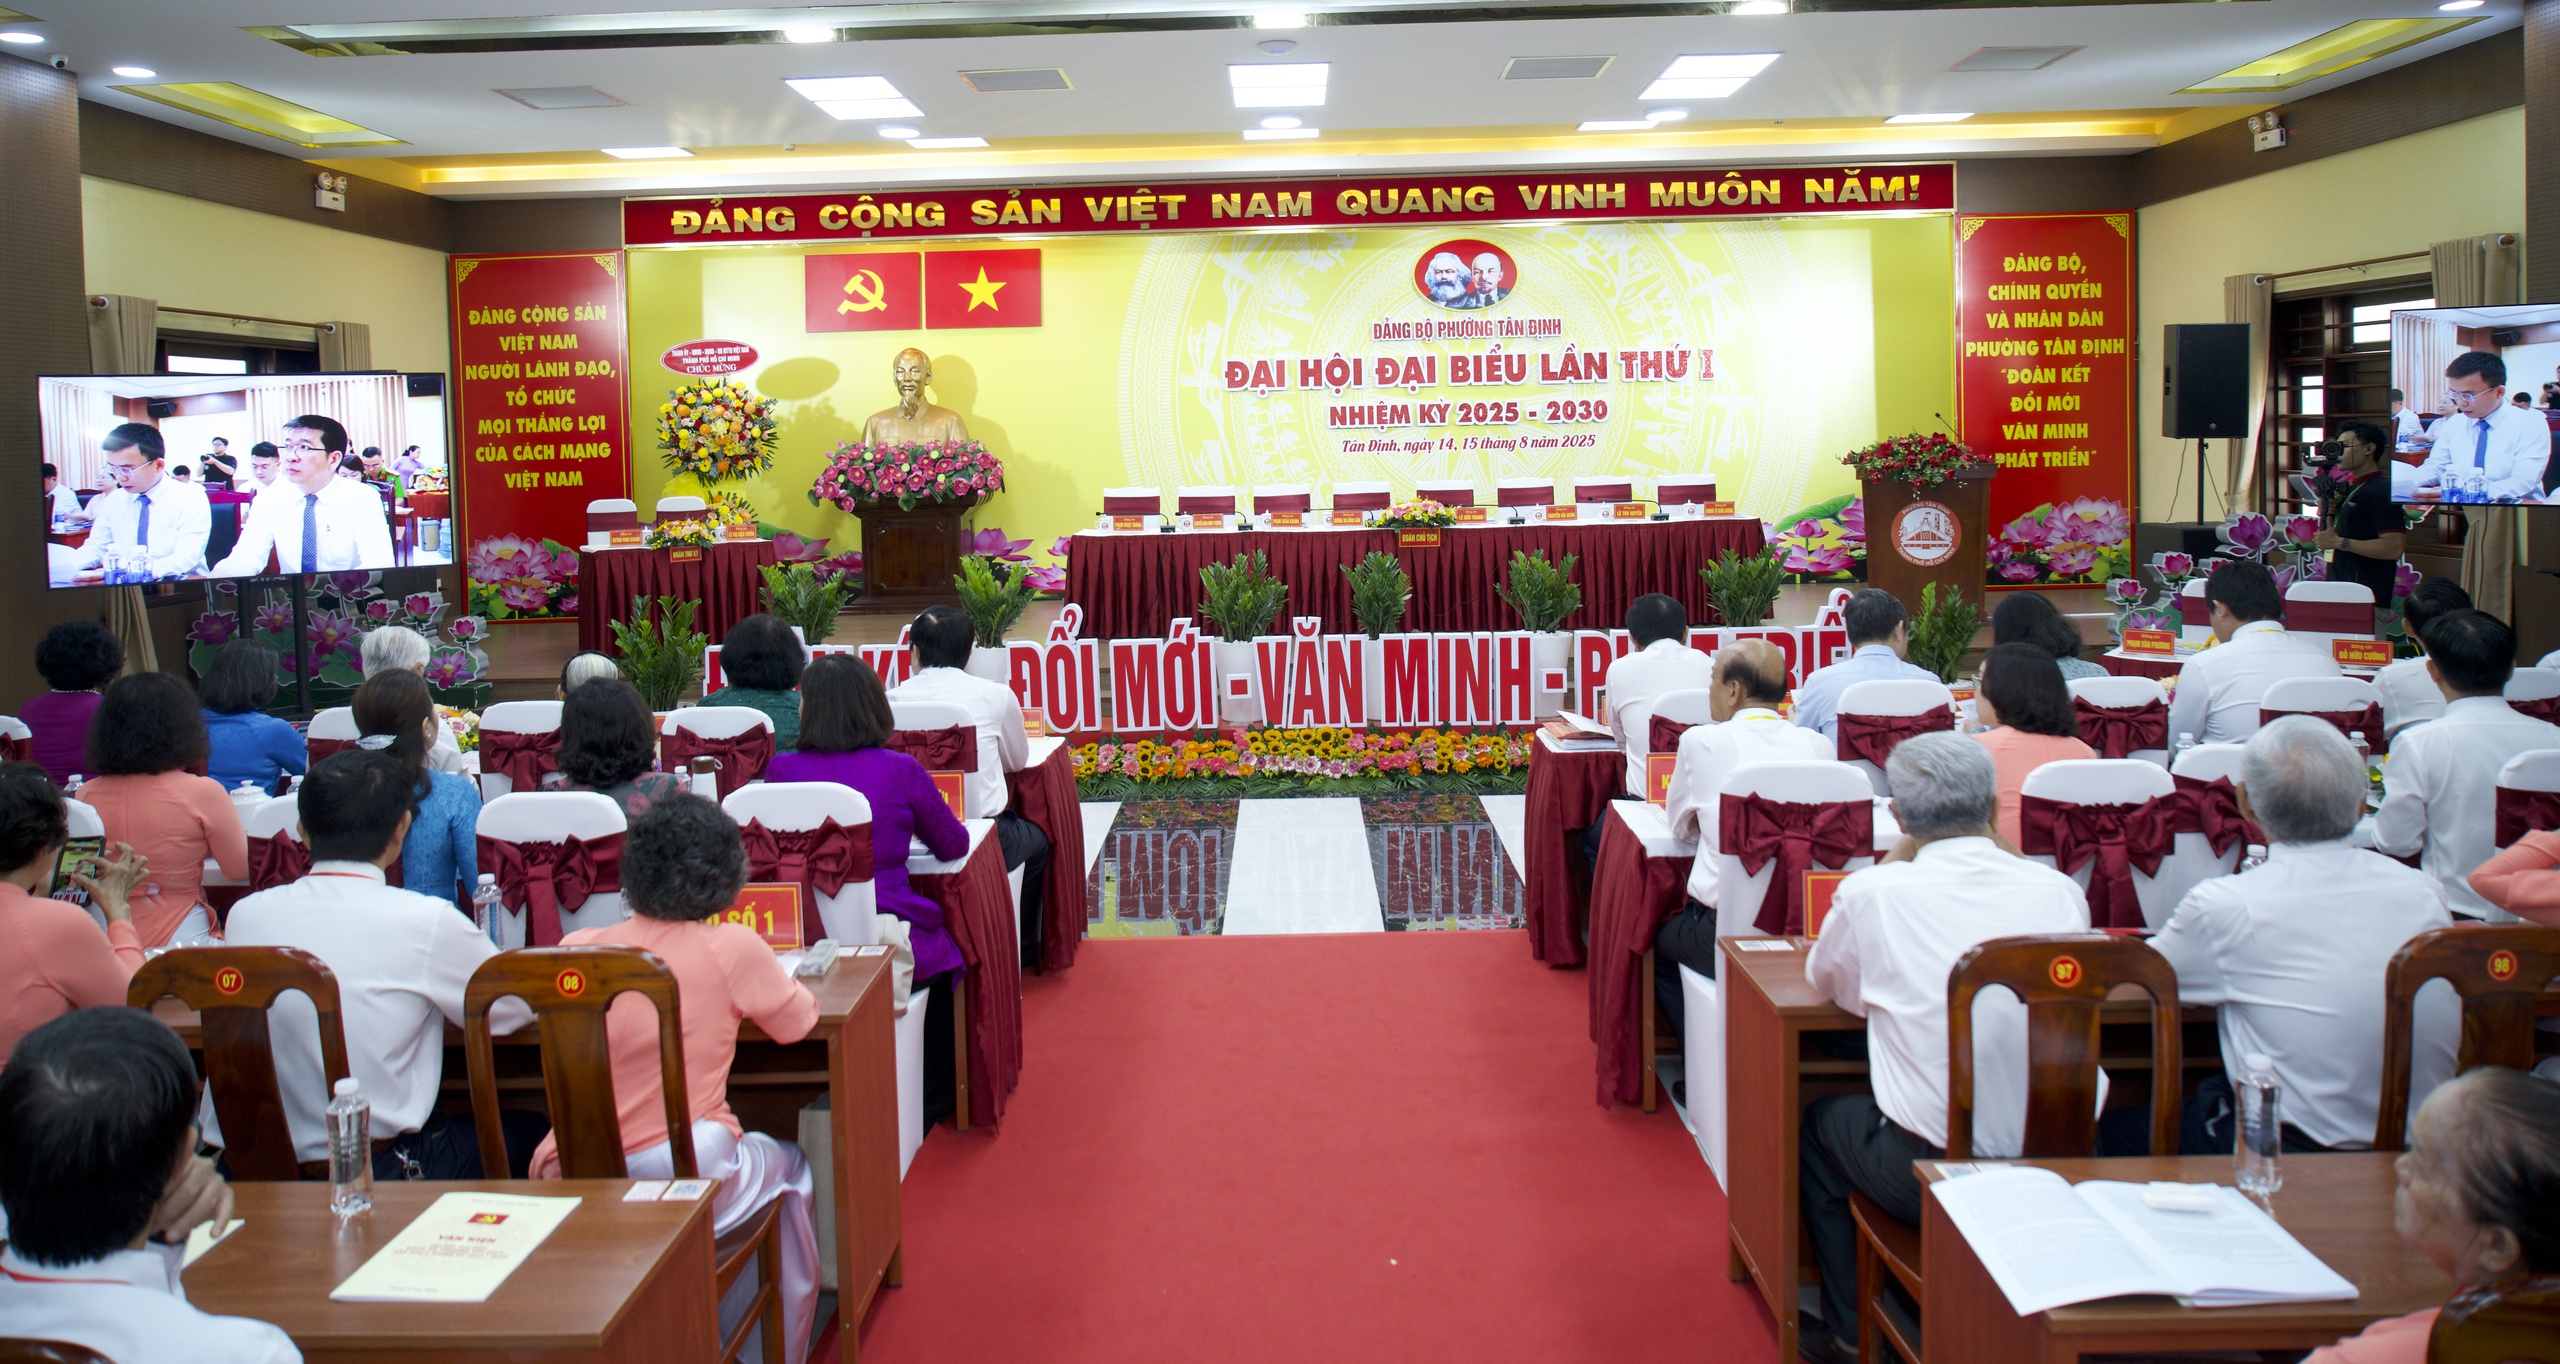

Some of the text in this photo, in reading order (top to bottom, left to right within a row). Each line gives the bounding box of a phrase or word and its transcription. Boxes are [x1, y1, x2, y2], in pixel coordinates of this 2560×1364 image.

[671, 169, 1921, 237] ĐẢNG CỘNG SẢN VIỆT NAM QUANG VINH MUÔN NĂM!
[2003, 253, 2087, 275] ĐẢNG BỘ,
[1988, 278, 2102, 301] CHÍNH QUYỀN
[469, 301, 607, 328] ĐẢNG CỘNG SẢN
[1986, 309, 2104, 329] VÀ NHÂN DÂN
[1373, 318, 1562, 342] ĐẢNG BỘ PHƯỜNG TÂN ĐỊNH
[499, 333, 578, 355] VIỆT NAM
[1966, 338, 2125, 359] PHƯỜNG TÂN ĐỊNH
[465, 359, 616, 380] NGƯỜI LÃNH ĐẠO,
[686, 362, 737, 373] CHÚC MỪNG
[1225, 343, 1714, 396] ĐẠI HỘI ĐẠI BIỂU LẦN THỨ I
[2061, 362, 2091, 383] KẾT
[506, 385, 576, 406] TỔ CHỨC
[2011, 391, 2080, 412] ĐỔI MỚI
[478, 411, 606, 438] MỌI THẮNG LỢI
[1330, 401, 1410, 431] NHIỆM
[1419, 398, 1452, 424] KỲ
[1459, 402, 1519, 424] 2025
[1547, 400, 1608, 422] 2030
[2002, 422, 2088, 440] VĂN MINH
[475, 441, 611, 462] CỦA CÁCH MẠNG
[1342, 434, 1596, 456] Tân Định, ngày 14, 15 tháng 8 năm 2025
[1995, 449, 2038, 468] PHÁT
[504, 470, 583, 491] VIỆT NAM
[1402, 533, 1415, 542] ĐOÀN
[1007, 604, 1097, 730] ĐỔI
[1112, 619, 1217, 729] MỚI
[1256, 618, 1365, 725] VĂN
[1382, 631, 1534, 724] MINH
[763, 910, 774, 936] 1
[2055, 963, 2074, 980] 97
[2494, 957, 2510, 973] 98
[222, 974, 237, 988] 07
[563, 975, 579, 991] 08
